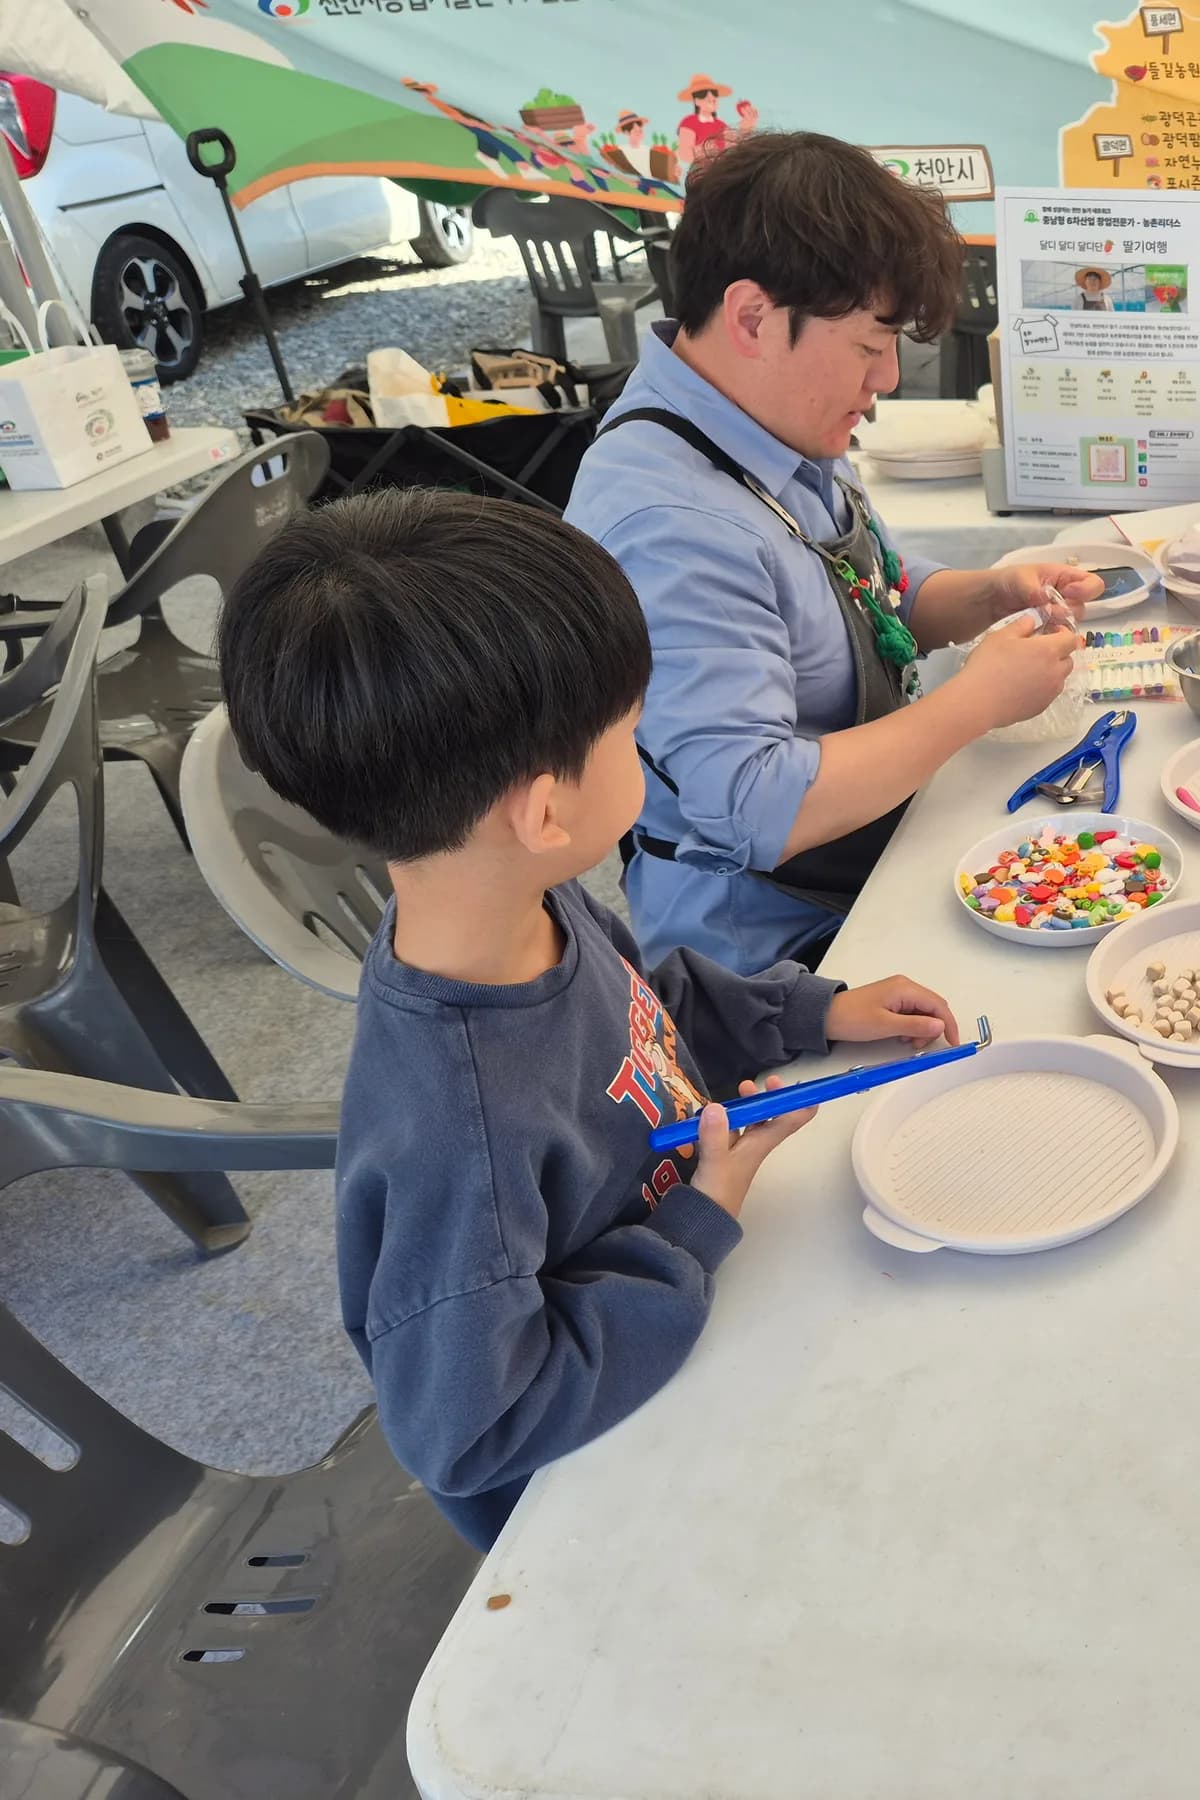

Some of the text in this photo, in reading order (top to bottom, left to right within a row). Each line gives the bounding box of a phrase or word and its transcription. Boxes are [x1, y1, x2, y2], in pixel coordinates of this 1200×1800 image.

[1150, 13, 1176, 26] 풍세면
[1149, 62, 1200, 80] 들길농원
[1102, 140, 1127, 151] 광덕면
[914, 156, 974, 185] 천안시
[1123, 240, 1168, 254] 딸기여행
